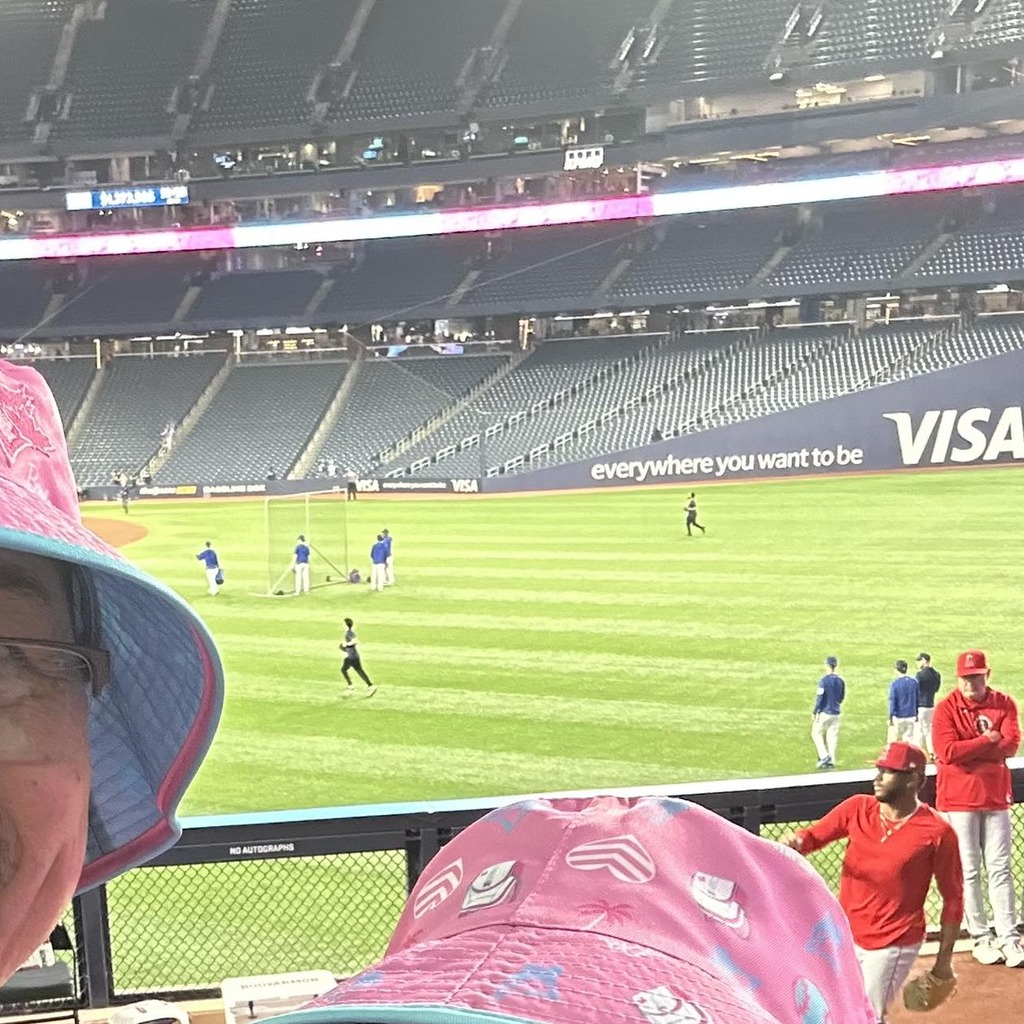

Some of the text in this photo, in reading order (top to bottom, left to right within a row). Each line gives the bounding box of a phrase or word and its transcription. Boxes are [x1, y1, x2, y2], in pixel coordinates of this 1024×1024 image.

[882, 406, 1024, 465] VISA
[590, 445, 864, 482] everywhere you want to be
[451, 479, 478, 492] VISA
[229, 843, 295, 855] NO AUTOGRAPHS
